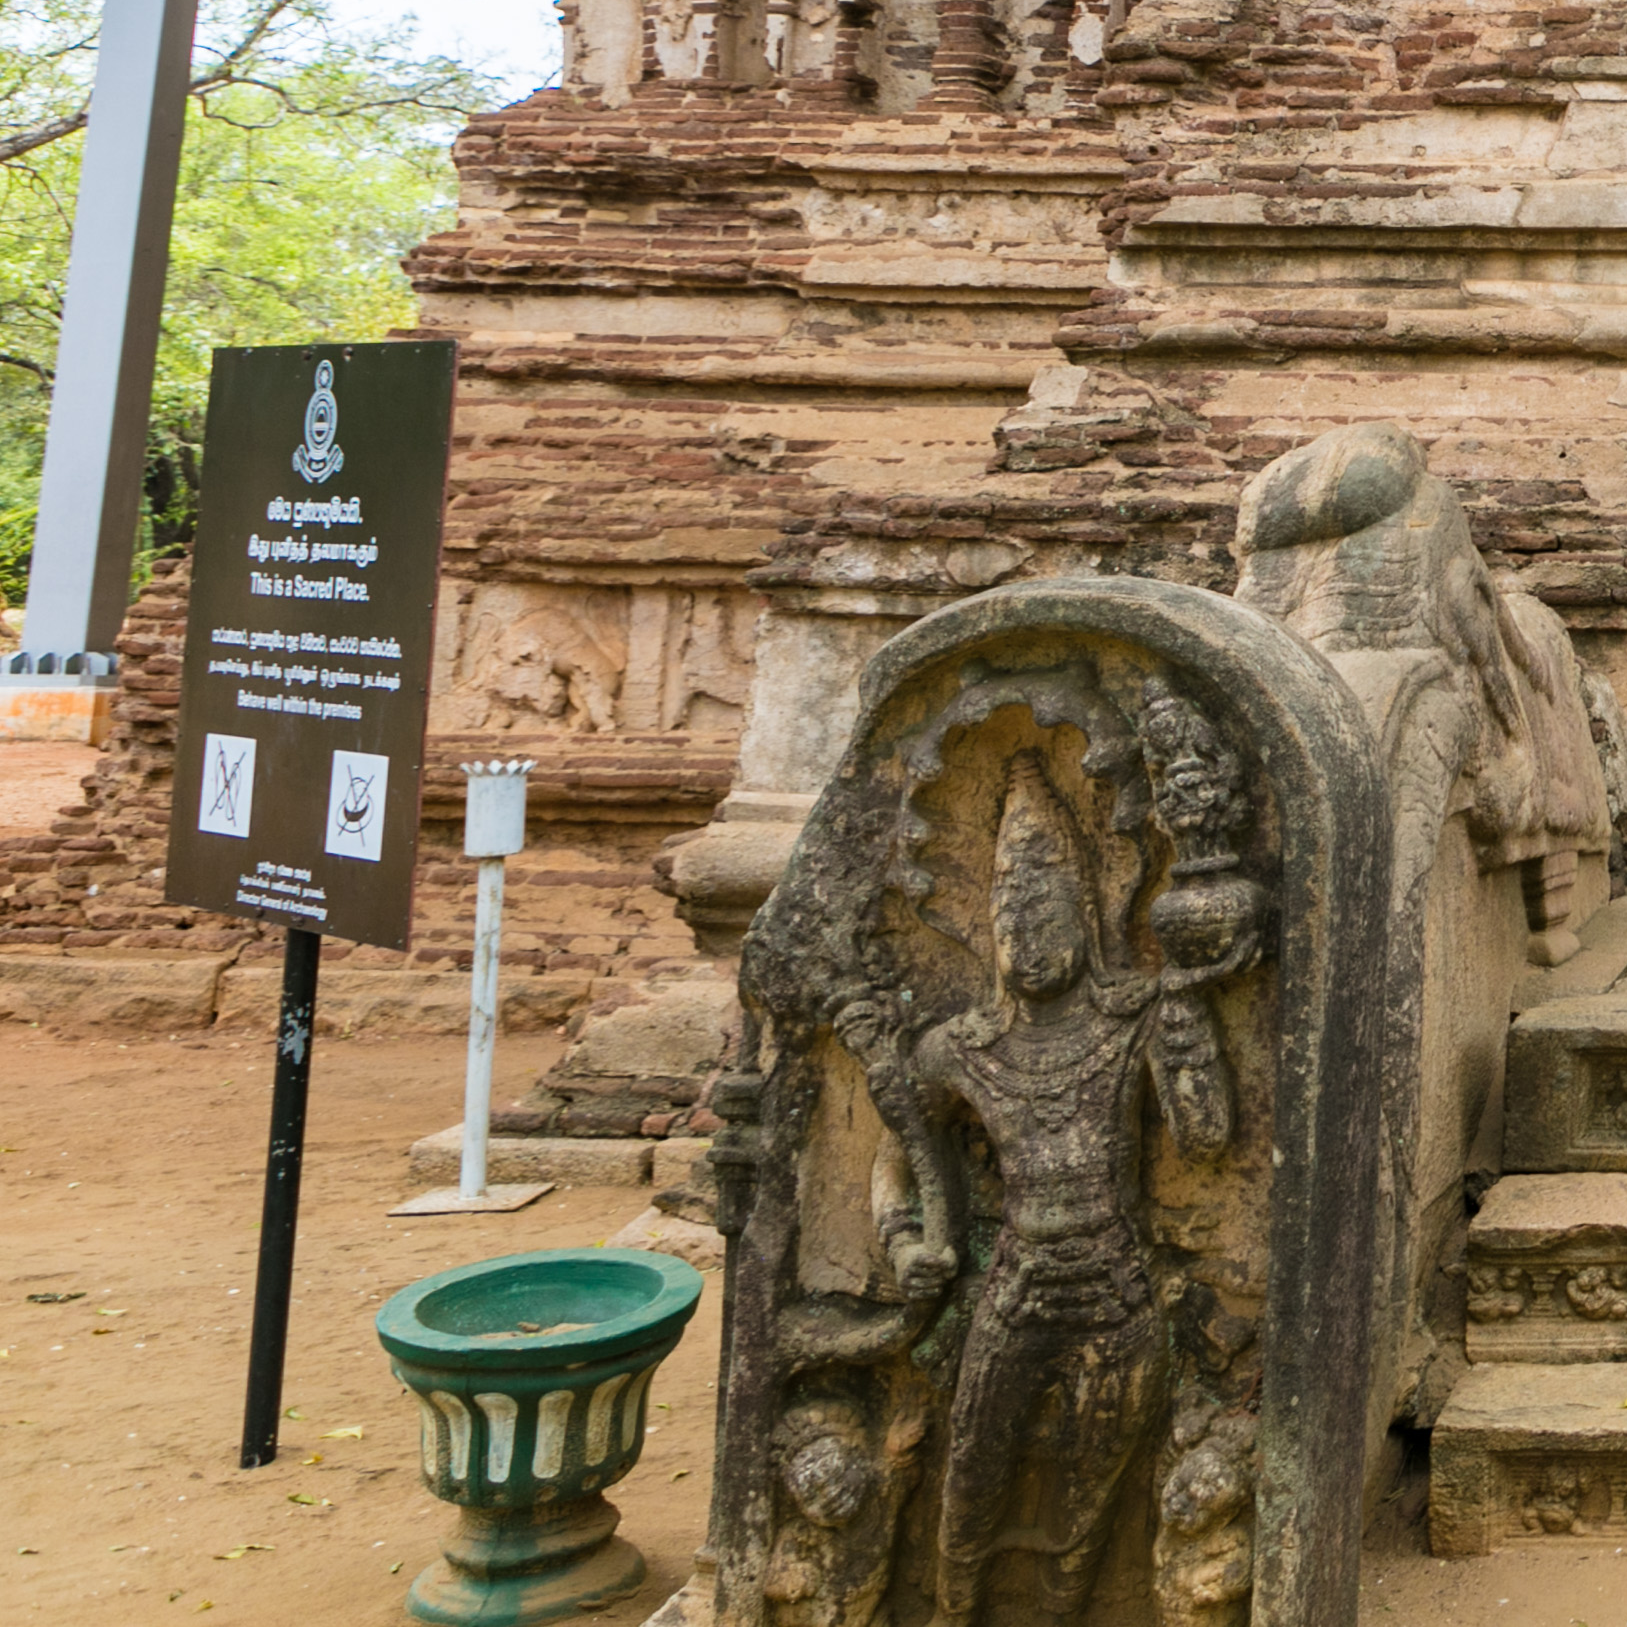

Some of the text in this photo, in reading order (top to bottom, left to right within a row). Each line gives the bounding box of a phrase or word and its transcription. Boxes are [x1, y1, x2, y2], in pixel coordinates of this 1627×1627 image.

[250, 572, 273, 596] This
[272, 573, 284, 596] is
[284, 579, 293, 597] a
[293, 574, 334, 599] Sacred
